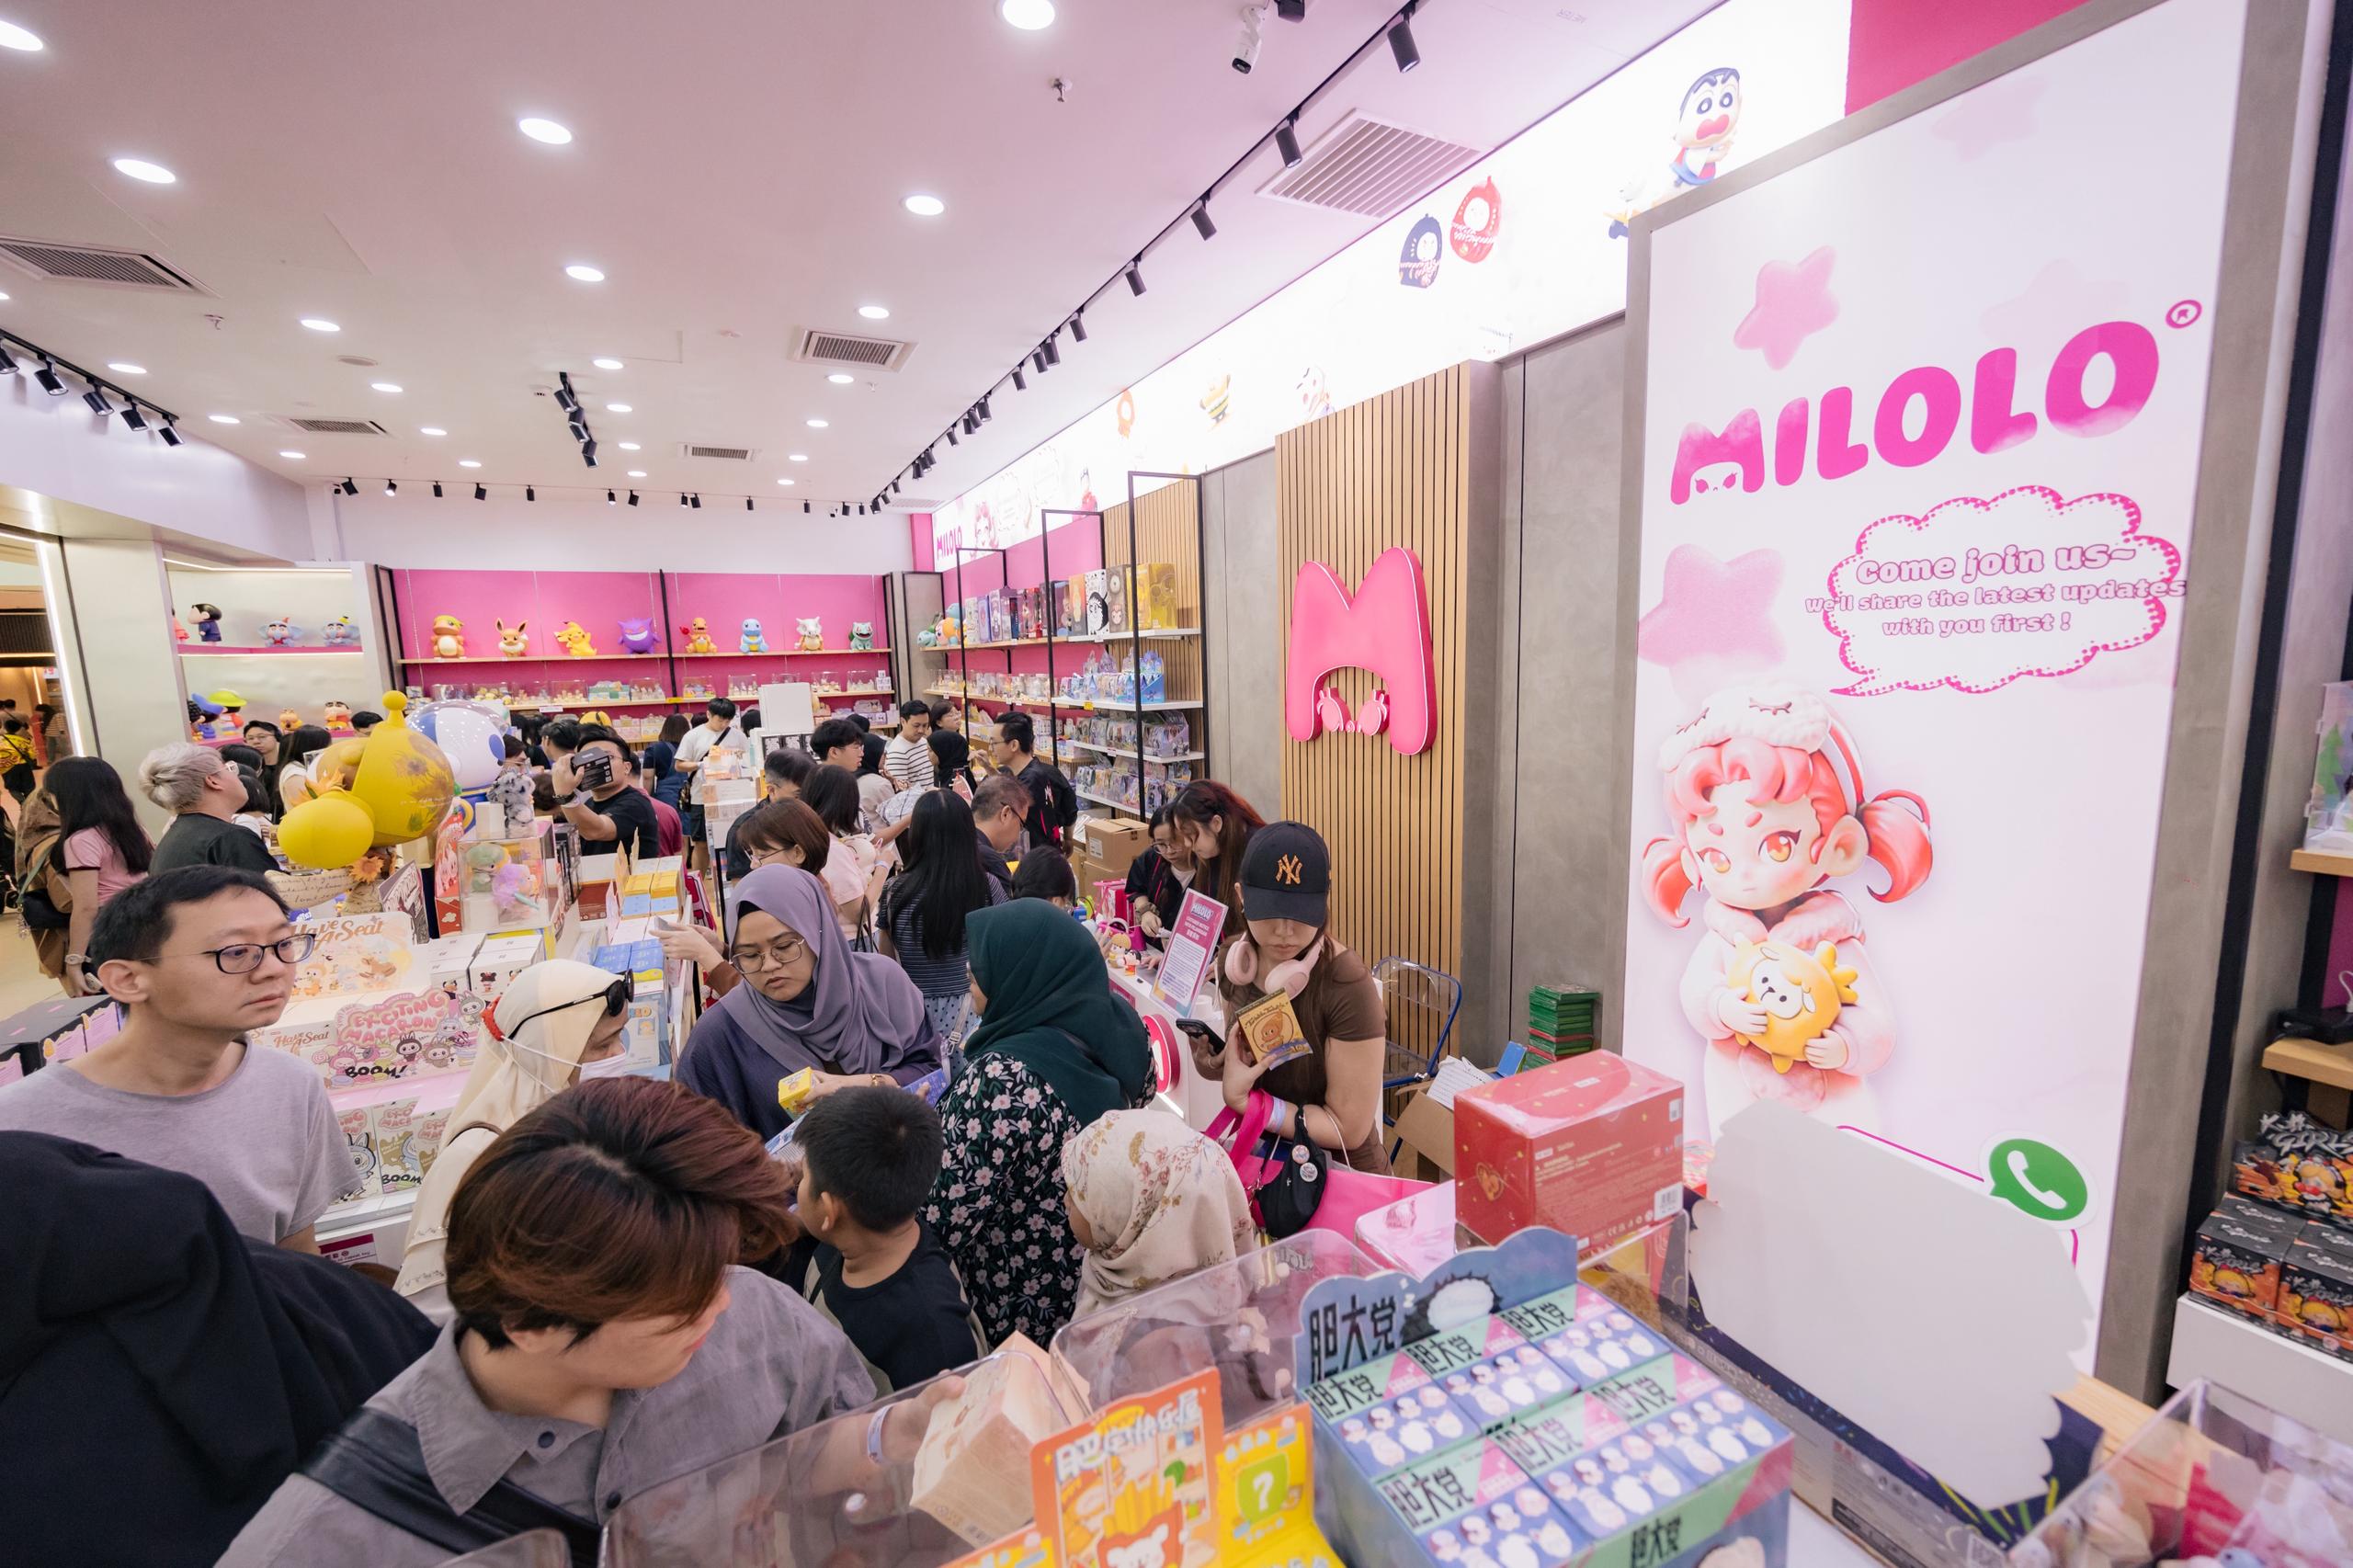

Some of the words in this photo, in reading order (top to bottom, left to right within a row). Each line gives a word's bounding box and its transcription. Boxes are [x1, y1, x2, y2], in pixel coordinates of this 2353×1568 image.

[1670, 321, 2159, 505] MILOLO
[938, 525, 962, 560] MILOLO
[1856, 557, 1957, 585] Come
[1961, 544, 2045, 584] join
[1858, 593, 1923, 611] share
[1927, 589, 1969, 608] the
[1974, 584, 2055, 605] latest
[2061, 578, 2187, 605] updates
[1882, 618, 1934, 636] with
[1938, 619, 1985, 638] you
[1991, 613, 2055, 632] first
[1285, 546, 1438, 756] M
[1276, 854, 1303, 885] NY
[341, 919, 384, 941] Seat
[347, 1016, 438, 1043] MACARON
[354, 992, 445, 1028] EXCITING
[302, 1030, 329, 1045] Seat
[1310, 1294, 1396, 1384] 胆大党
[1500, 1301, 1574, 1340] 胆大党
[1406, 1335, 1483, 1375] 胆大党
[1305, 1373, 1383, 1420] 胆大党
[1495, 1416, 1584, 1471] 胆大党
[1381, 1466, 1474, 1529] 胆大党
